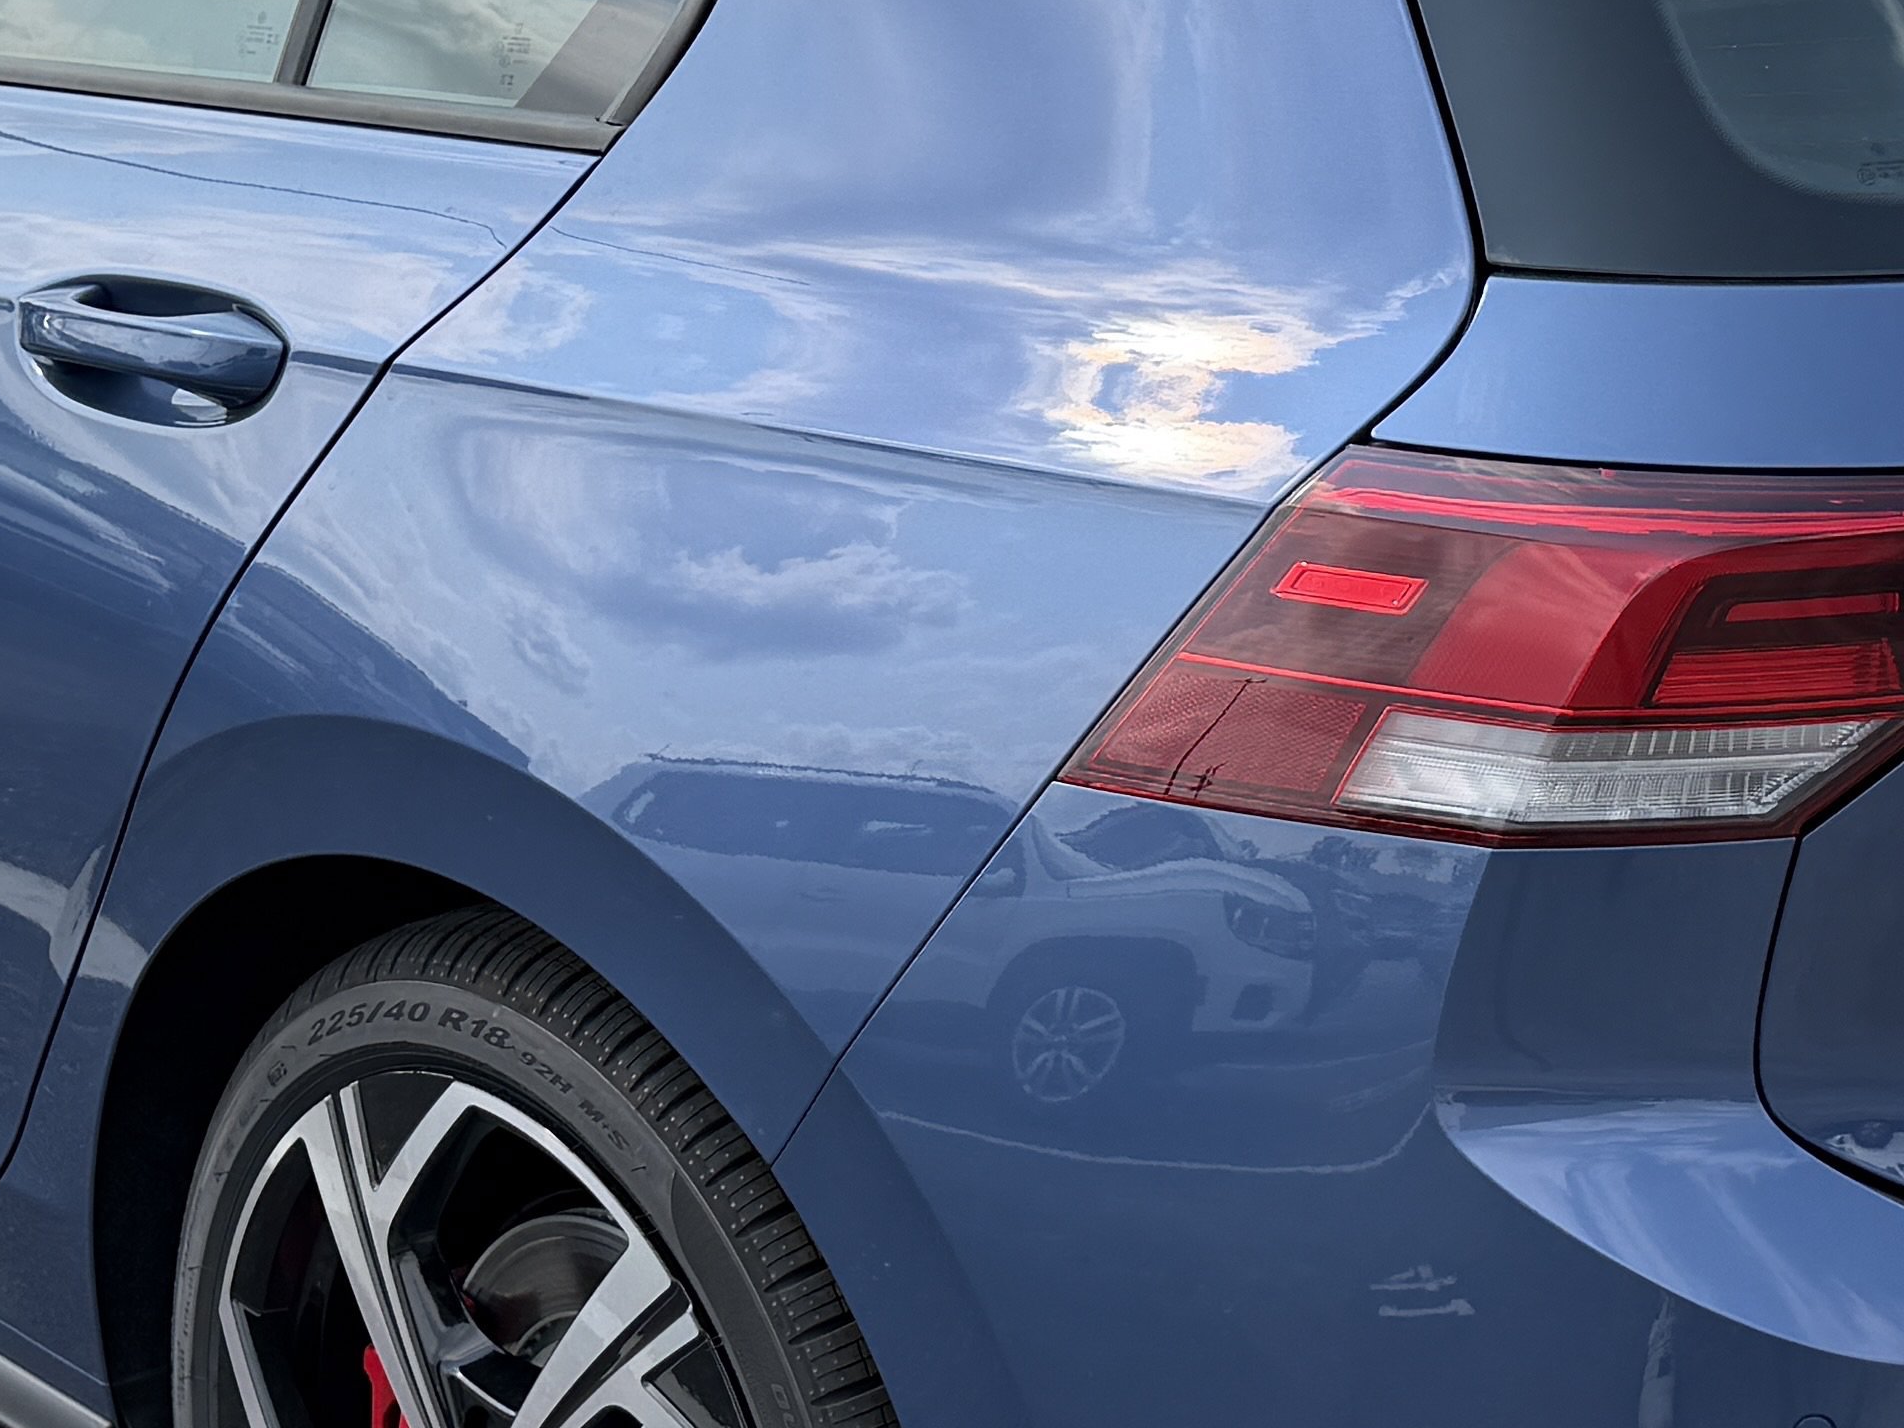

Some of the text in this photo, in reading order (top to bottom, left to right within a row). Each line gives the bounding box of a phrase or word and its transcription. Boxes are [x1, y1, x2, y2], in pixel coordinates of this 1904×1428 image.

[307, 999, 631, 1152] 225/40 R18 92H M+S
